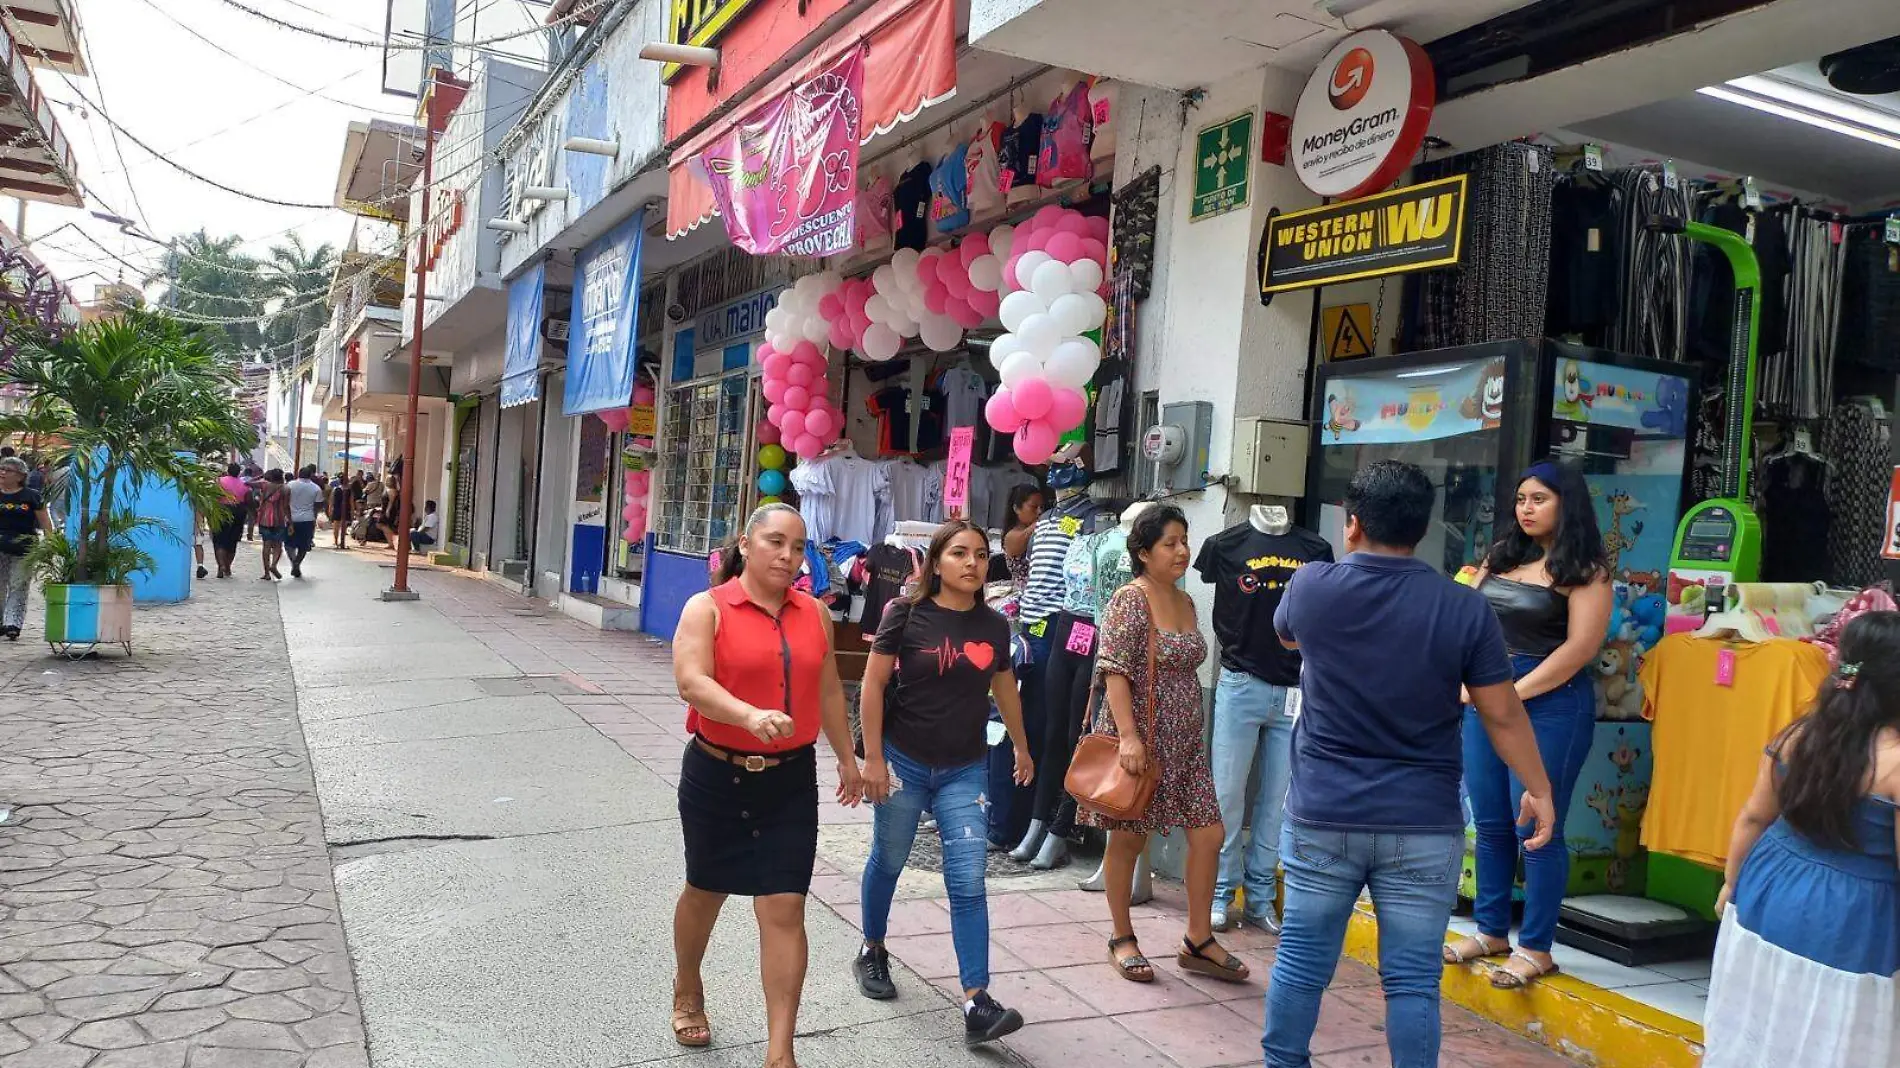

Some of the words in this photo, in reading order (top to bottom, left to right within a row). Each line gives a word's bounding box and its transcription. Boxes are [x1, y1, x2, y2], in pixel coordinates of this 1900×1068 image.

[1367, 129, 1395, 146] dinero
[1203, 190, 1226, 204] PUNTO
[1227, 187, 1237, 198] DE
[1278, 209, 1375, 246] WESTERN
[1387, 193, 1453, 246] WU
[1304, 231, 1373, 261] UNION
